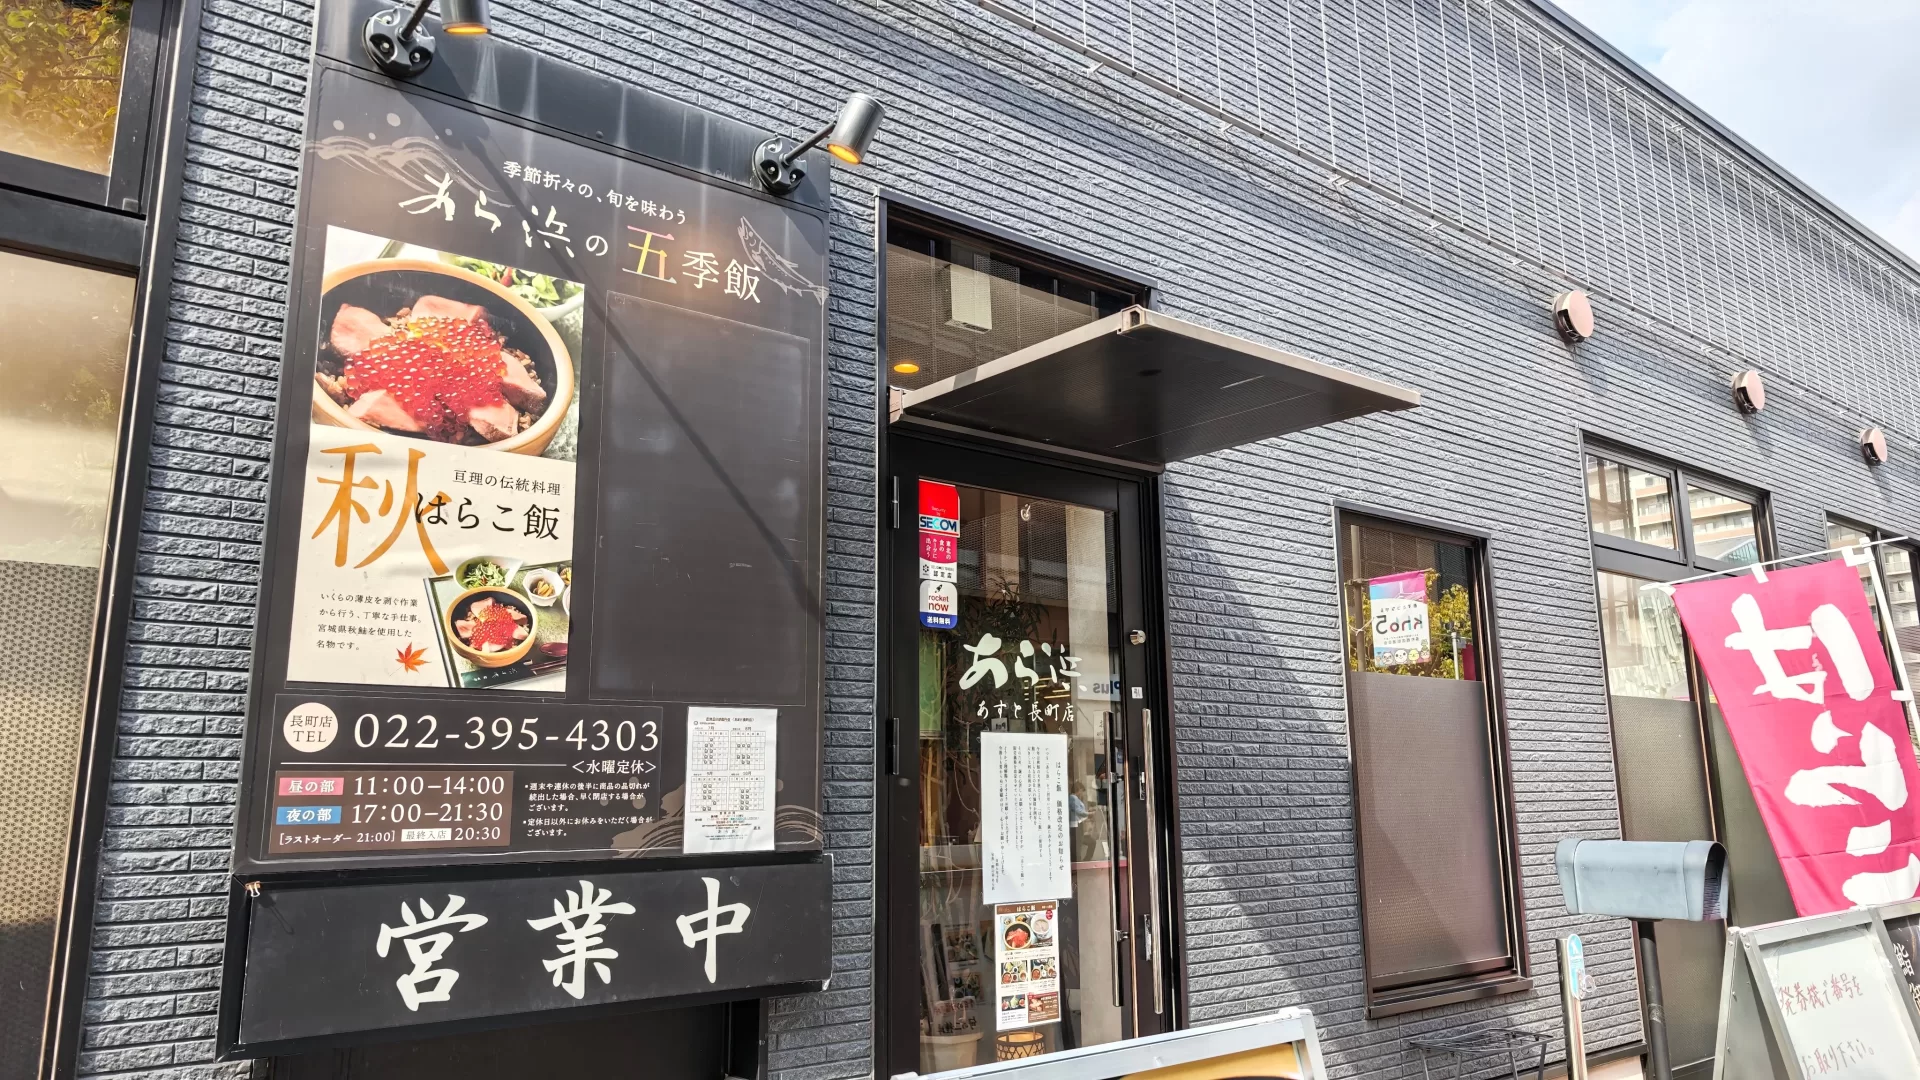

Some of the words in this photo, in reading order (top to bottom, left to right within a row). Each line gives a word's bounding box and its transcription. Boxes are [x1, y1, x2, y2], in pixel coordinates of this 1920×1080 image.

[502, 160, 687, 225] 季節折々の、旬を味わう
[453, 469, 561, 496] 亘理の伝統料理
[311, 443, 451, 576] 秋
[415, 492, 560, 541] はらこ飯
[919, 516, 957, 531] SECOM
[321, 592, 418, 607] いくらの薄皮を剥ぐ作業
[928, 594, 949, 603] rocket
[928, 602, 949, 612] now
[319, 608, 422, 624] から行う、丁寧な手仕事。
[926, 616, 951, 625] 送料無料
[317, 624, 412, 638] 宮城県秋鮭を使用した
[316, 639, 360, 651] 名物です。
[976, 700, 1075, 722] あすと長町店
[290, 715, 333, 730] 長町店
[294, 731, 327, 744] TEL
[354, 713, 659, 752] 022-395-4303
[288, 780, 335, 794] 昼の部
[286, 808, 332, 823] 夜の部
[528, 804, 569, 812] ございます。
[405, 829, 447, 841] 最終入店
[454, 826, 501, 841] 20:30
[526, 828, 567, 837] ございます。
[376, 876, 752, 1011] 営業中
[1780, 973, 1863, 1016] 発券機で番号を
[1801, 1038, 1875, 1080] お取り下さい。
